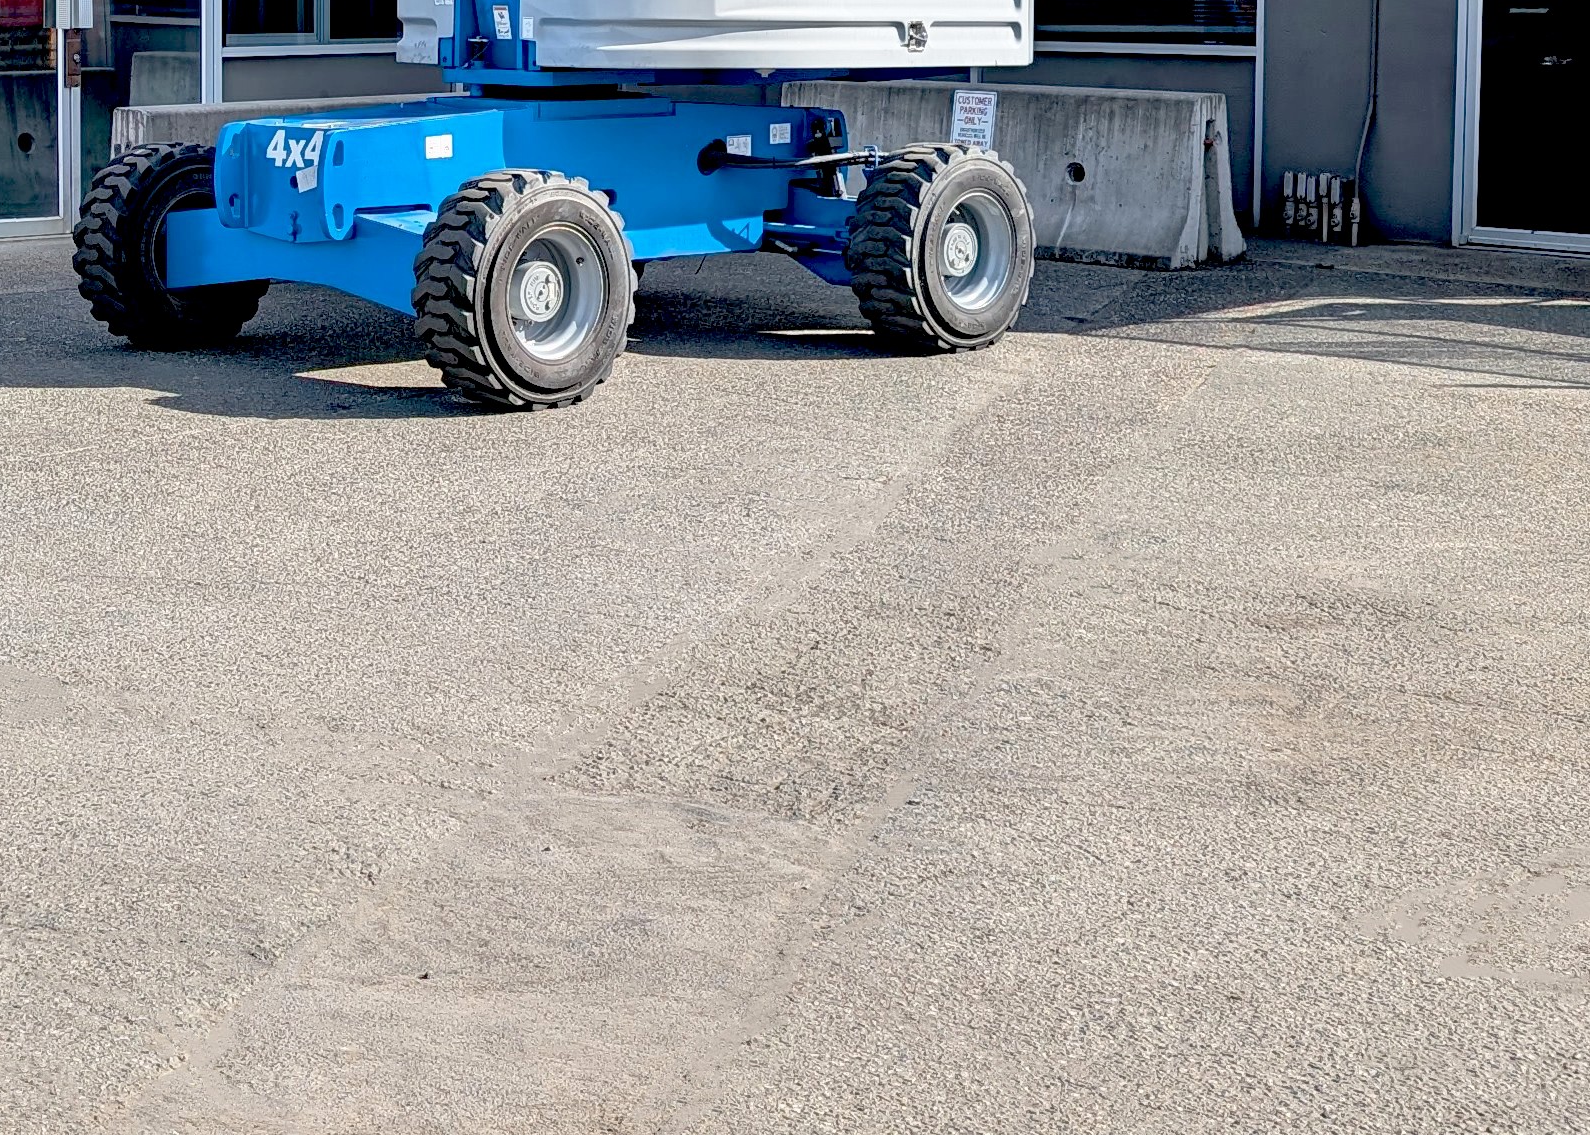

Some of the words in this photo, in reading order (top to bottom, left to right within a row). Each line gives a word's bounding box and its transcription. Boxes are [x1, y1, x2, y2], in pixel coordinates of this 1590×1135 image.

[957, 95, 993, 106] CUSTOMER
[959, 105, 988, 116] PARKING
[265, 128, 325, 168] 4x4
